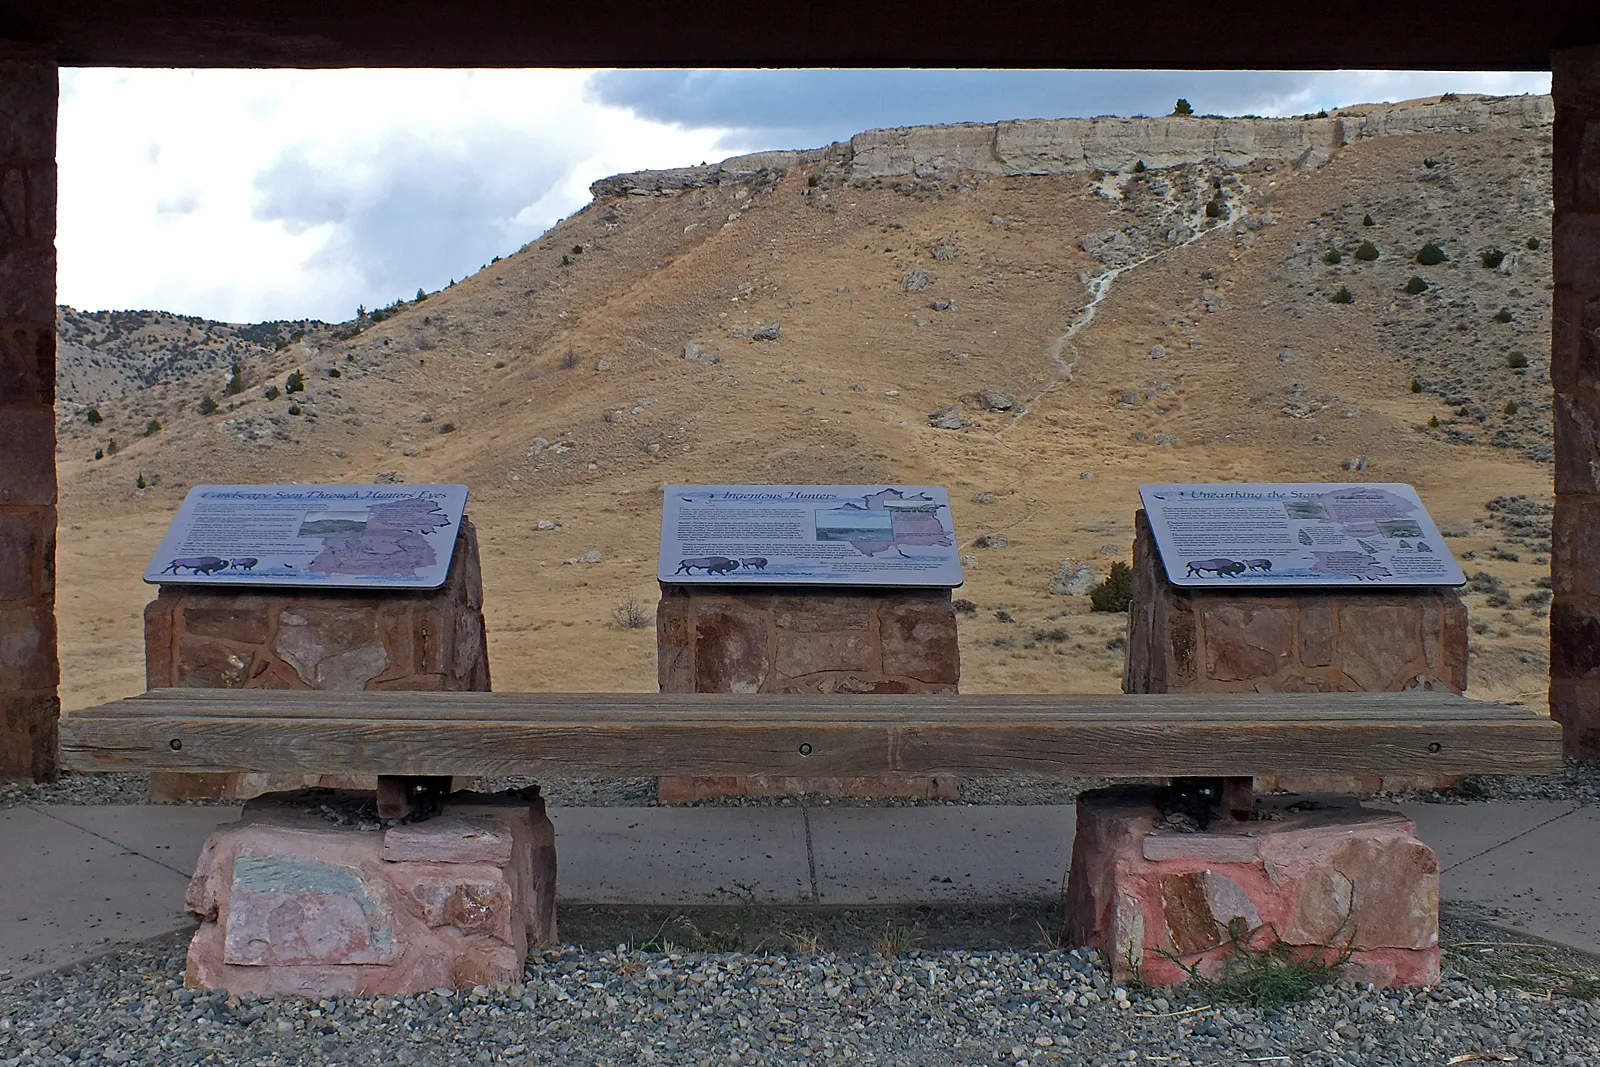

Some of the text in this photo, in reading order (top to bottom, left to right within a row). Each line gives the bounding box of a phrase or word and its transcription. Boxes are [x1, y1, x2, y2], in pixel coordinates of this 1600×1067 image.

[275, 491, 303, 500] Seen
[307, 490, 359, 501] Through
[418, 490, 447, 501] Eyes
[723, 491, 838, 500] Ingenious Hunters
[1191, 491, 1324, 500] Unearthing the Story
